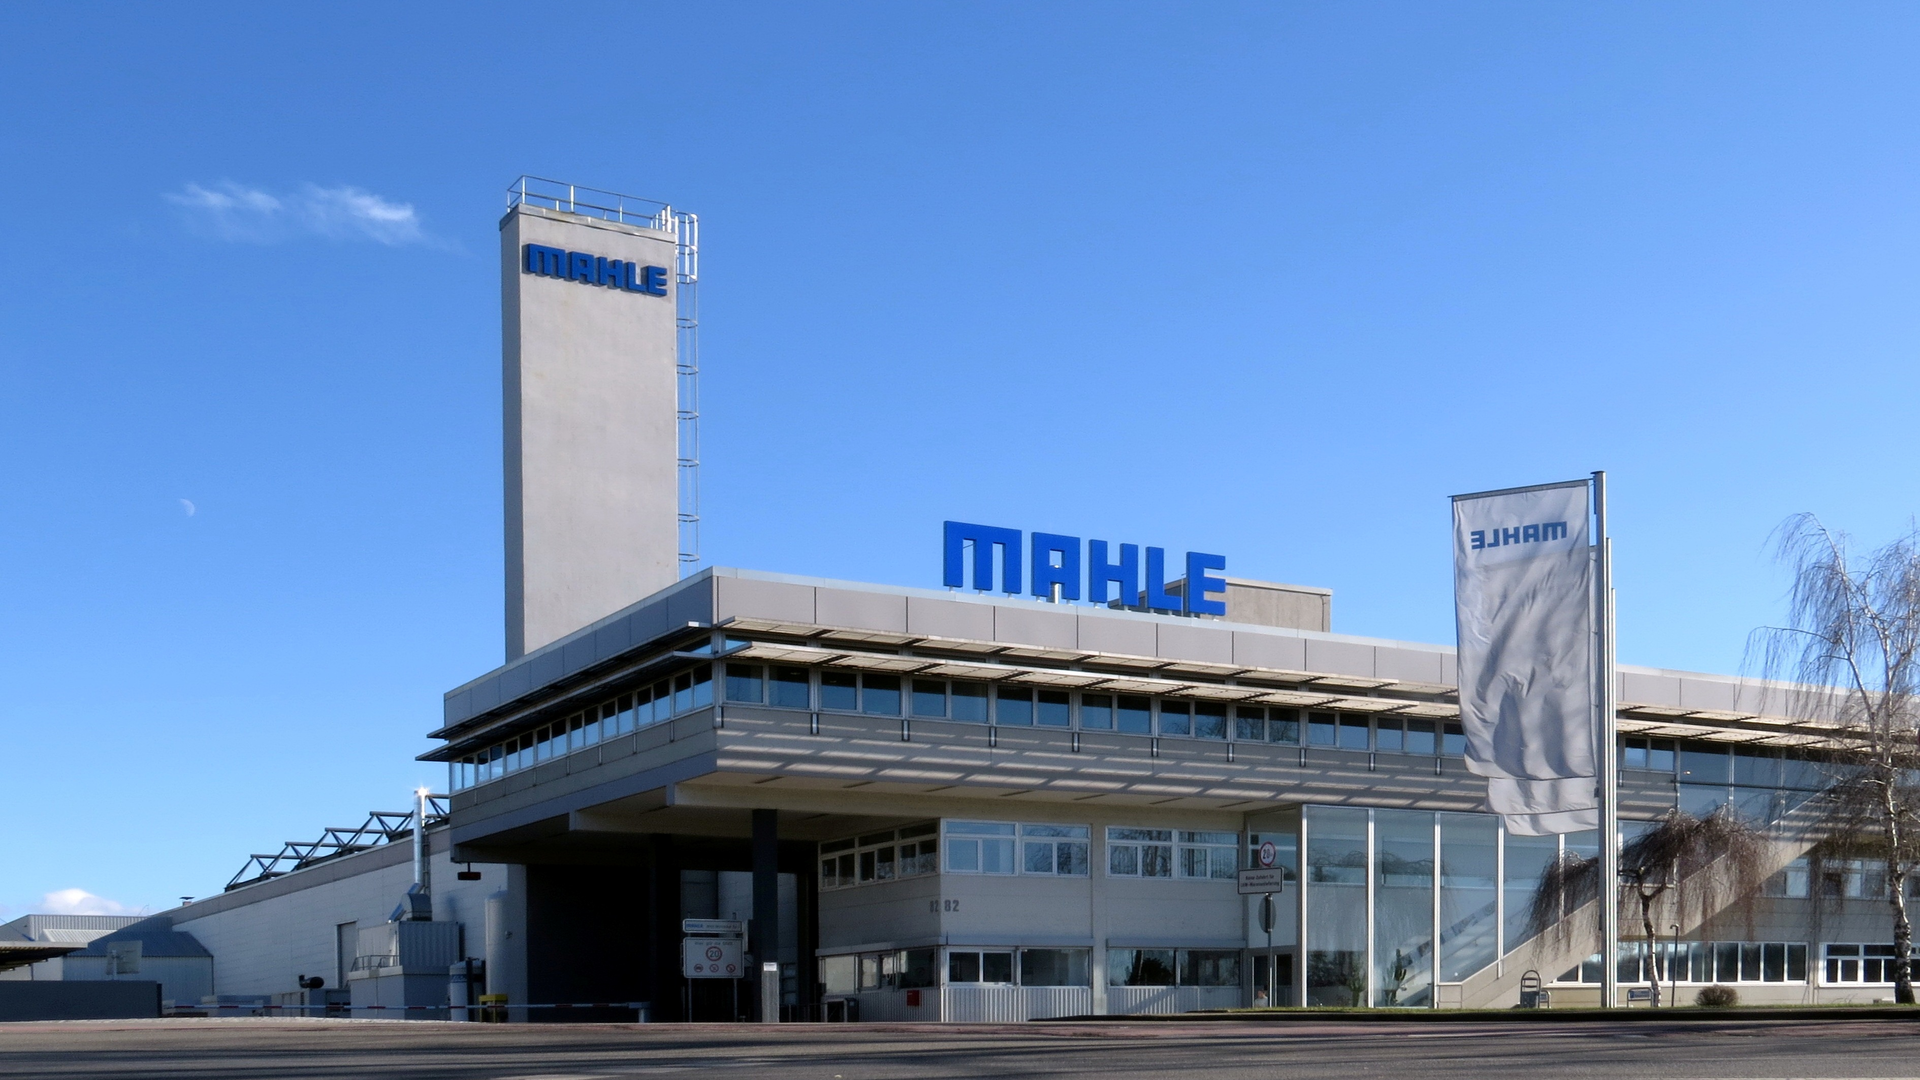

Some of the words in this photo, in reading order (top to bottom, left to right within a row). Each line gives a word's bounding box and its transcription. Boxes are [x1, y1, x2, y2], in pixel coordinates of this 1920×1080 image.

[525, 243, 667, 296] MAHLE
[943, 520, 1226, 615] MAHLE
[944, 899, 959, 912] 82
